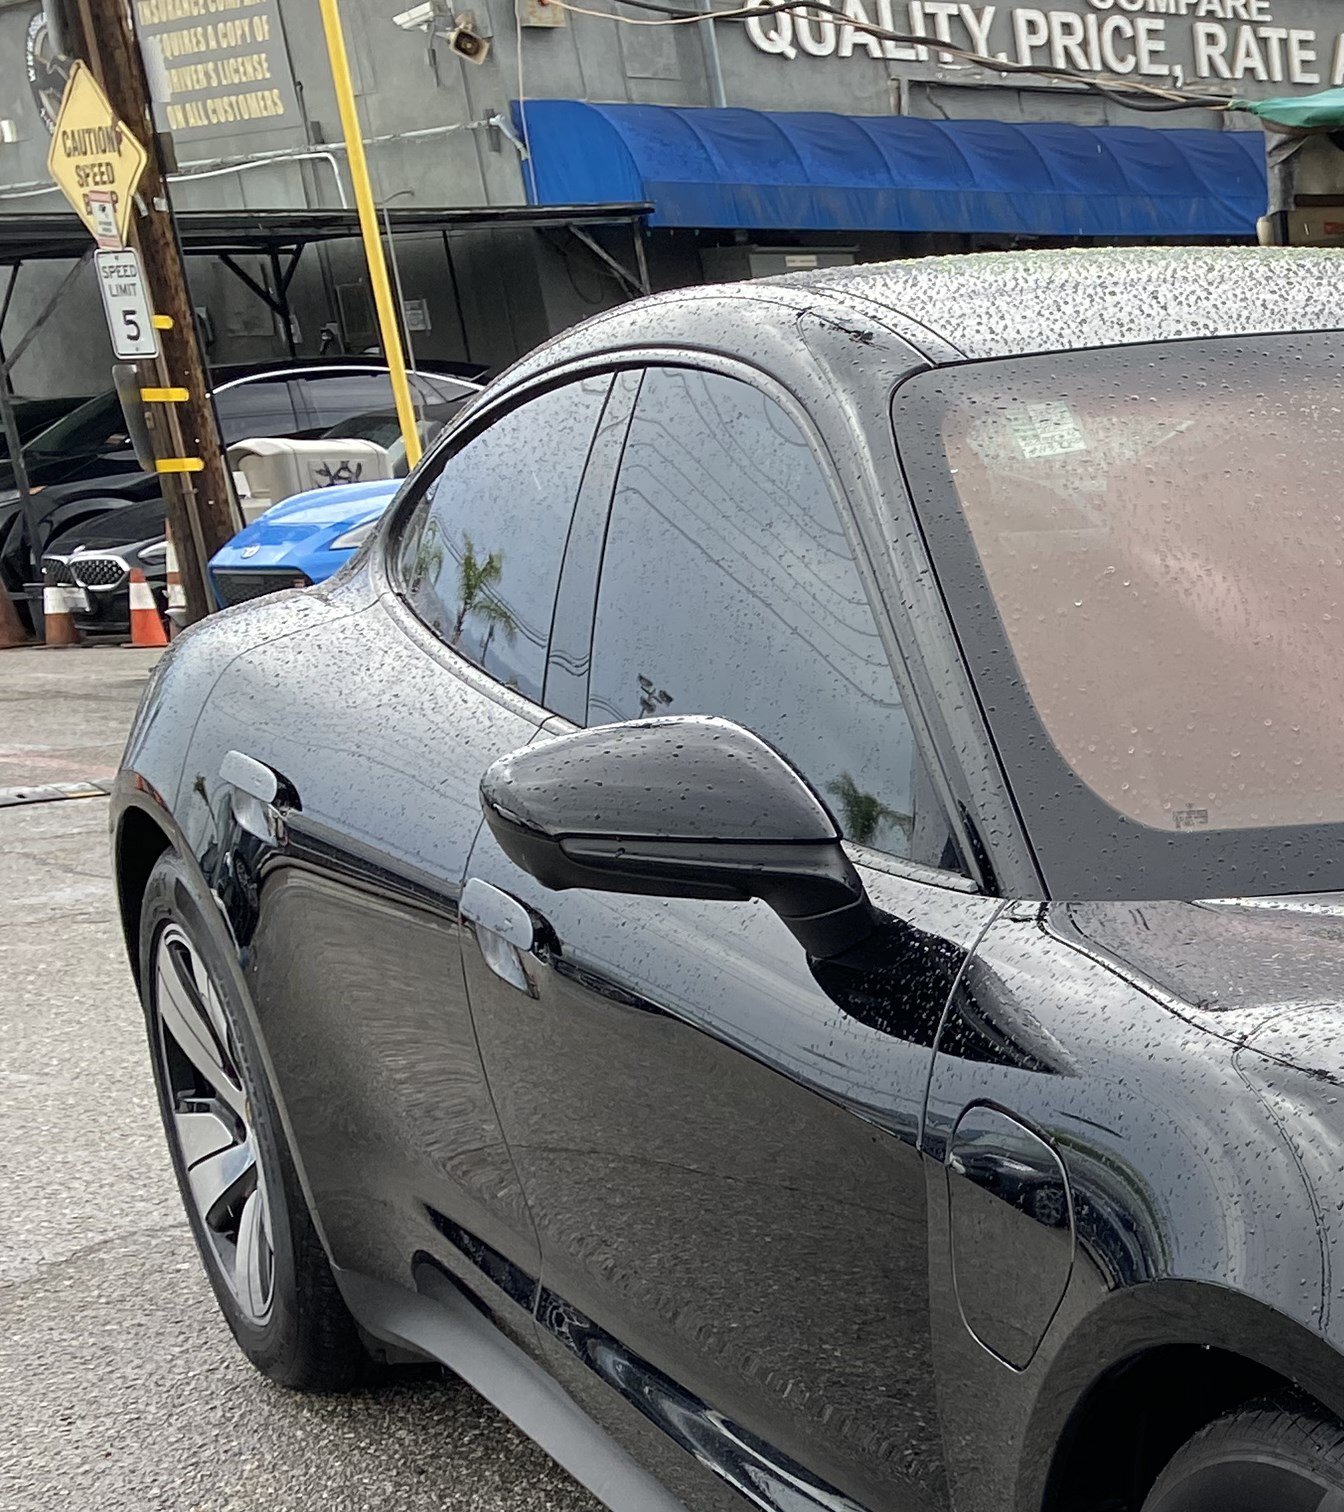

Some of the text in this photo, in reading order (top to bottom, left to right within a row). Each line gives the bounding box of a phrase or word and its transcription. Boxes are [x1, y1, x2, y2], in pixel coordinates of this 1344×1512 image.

[207, 25, 217, 50] A
[217, 18, 251, 49] COPY
[253, 15, 270, 42] OF
[1013, 8, 1184, 88] PRICE,
[1192, 22, 1320, 84] RATE
[167, 53, 271, 93] RIVER'S LICENSE
[166, 89, 284, 130] ON ALL CUSTOMERS
[62, 126, 117, 158] CAUTION
[75, 162, 115, 188] SPEED
[101, 264, 137, 279] SPEED
[108, 283, 137, 298] LIMIT
[122, 309, 140, 341] 5
